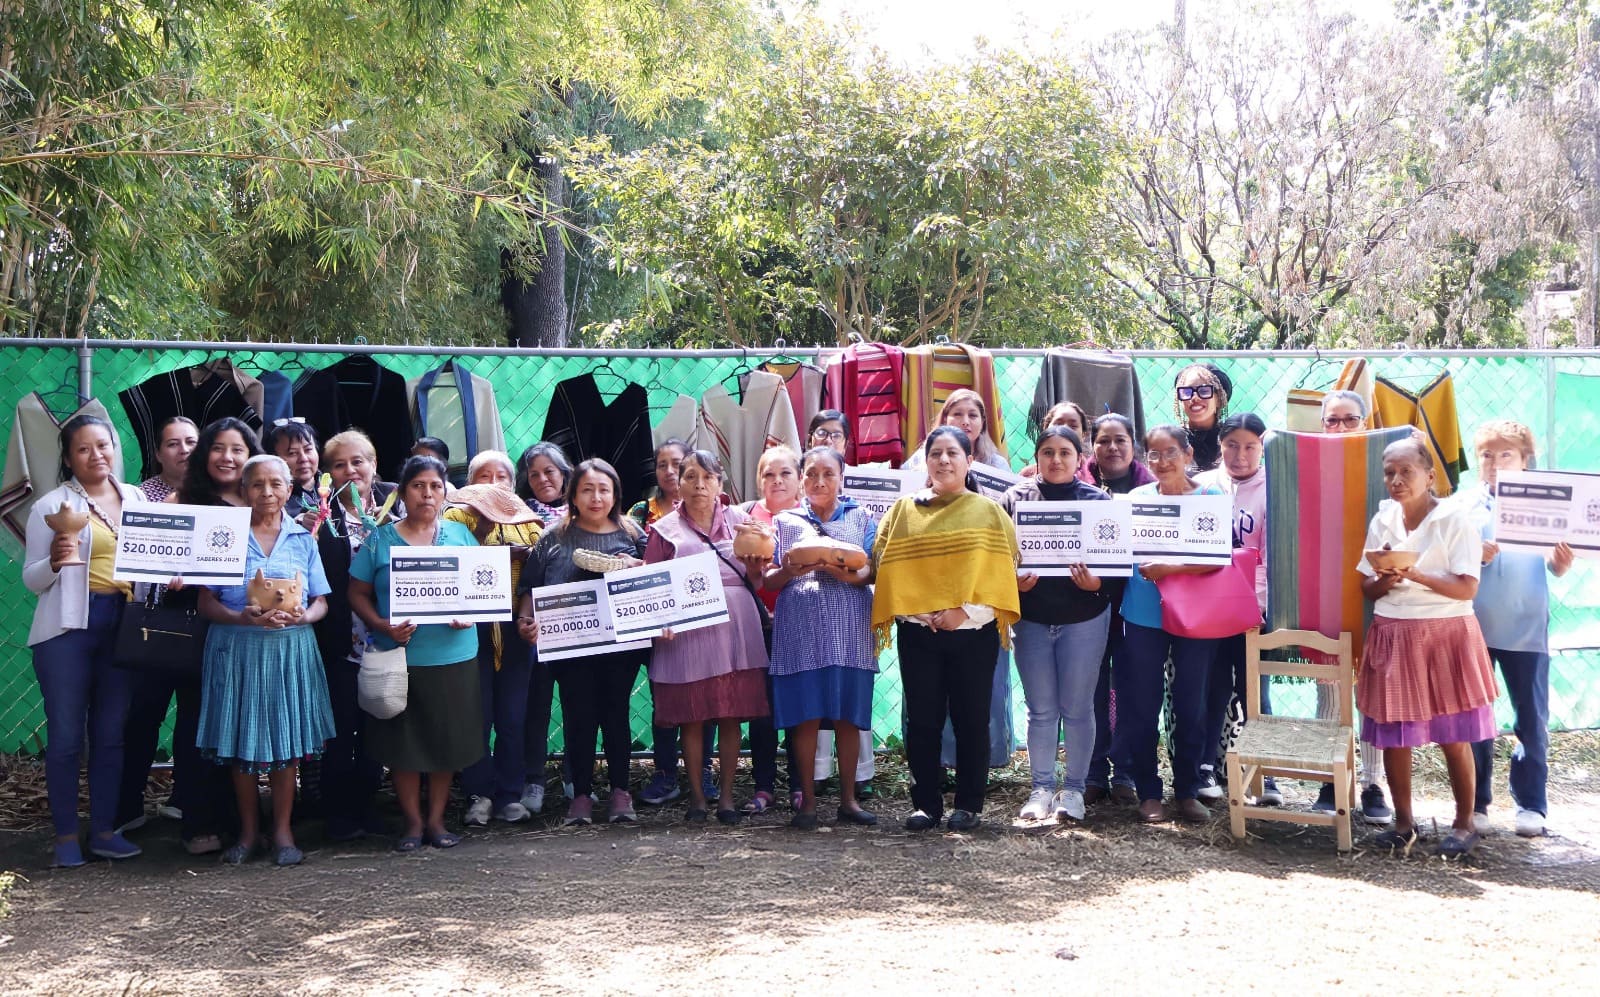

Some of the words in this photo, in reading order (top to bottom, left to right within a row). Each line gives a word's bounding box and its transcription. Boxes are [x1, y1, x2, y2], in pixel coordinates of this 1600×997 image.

[122, 542, 192, 557] $20,000.00
[1021, 540, 1081, 551] $20,000.00
[395, 586, 459, 598] $20,000.00
[615, 598, 676, 618] $20,000.00
[681, 601, 705, 610] SABERES
[540, 618, 600, 636] $20,000.00
